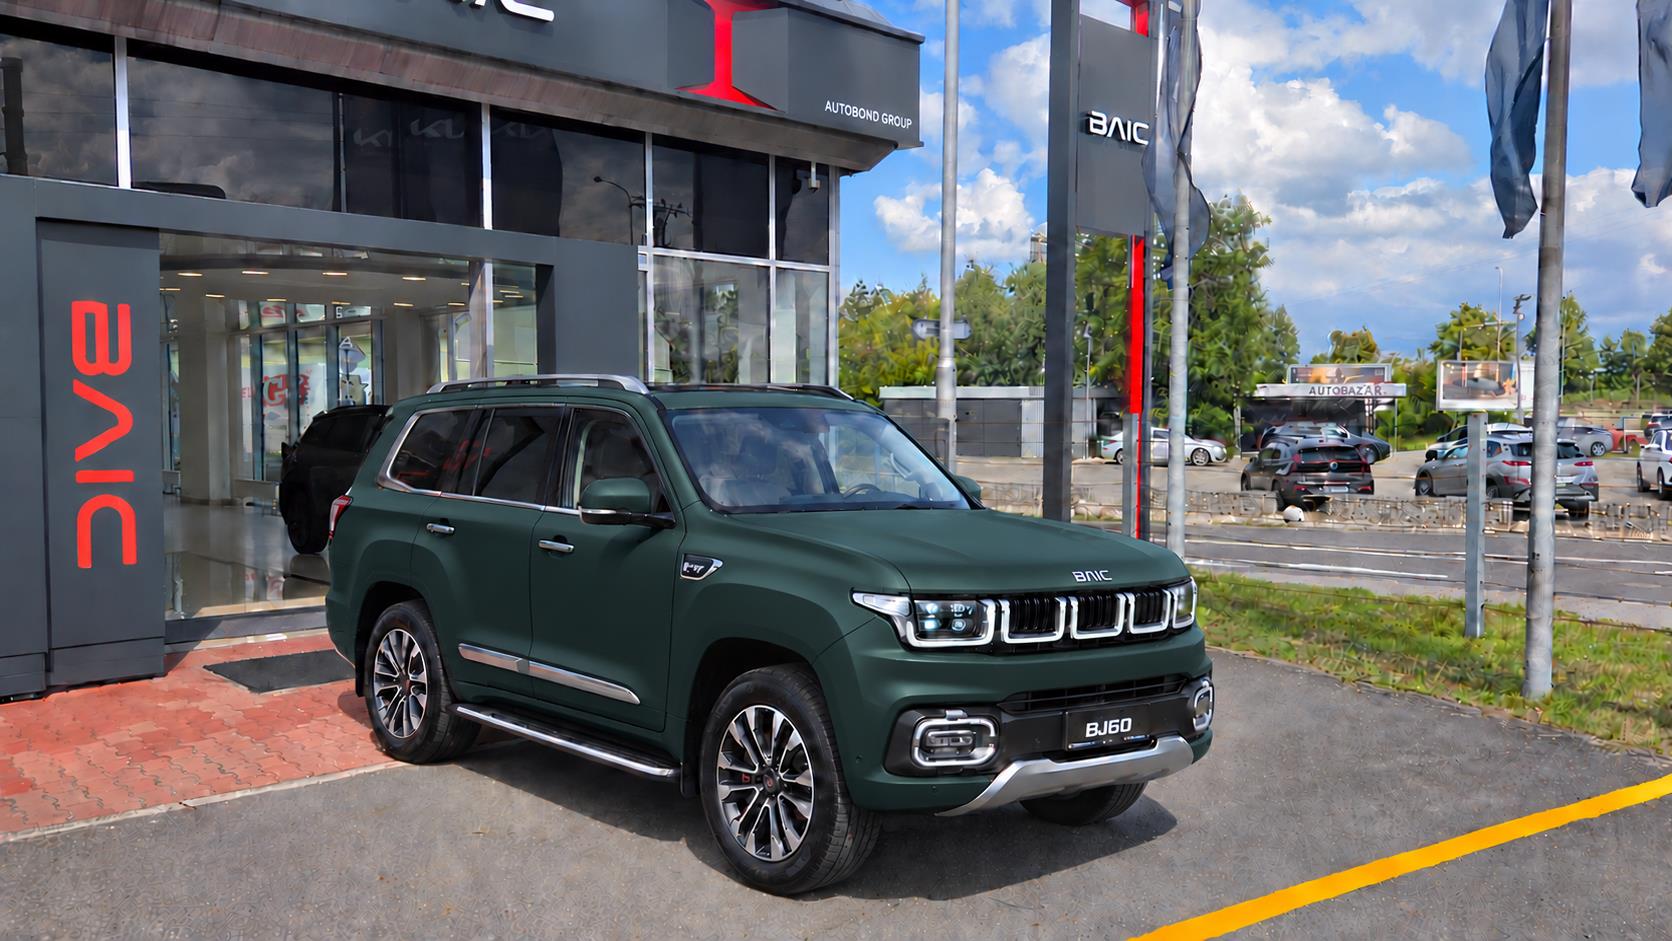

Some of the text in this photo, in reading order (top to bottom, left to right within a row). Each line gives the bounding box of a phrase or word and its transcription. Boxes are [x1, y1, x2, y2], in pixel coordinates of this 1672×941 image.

[824, 100, 913, 129] AUTOBOND GROUP
[1089, 110, 1150, 146] BAIC
[71, 300, 138, 569] BAIC
[1071, 569, 1113, 582] BAIC
[1085, 717, 1132, 738] BJ60
